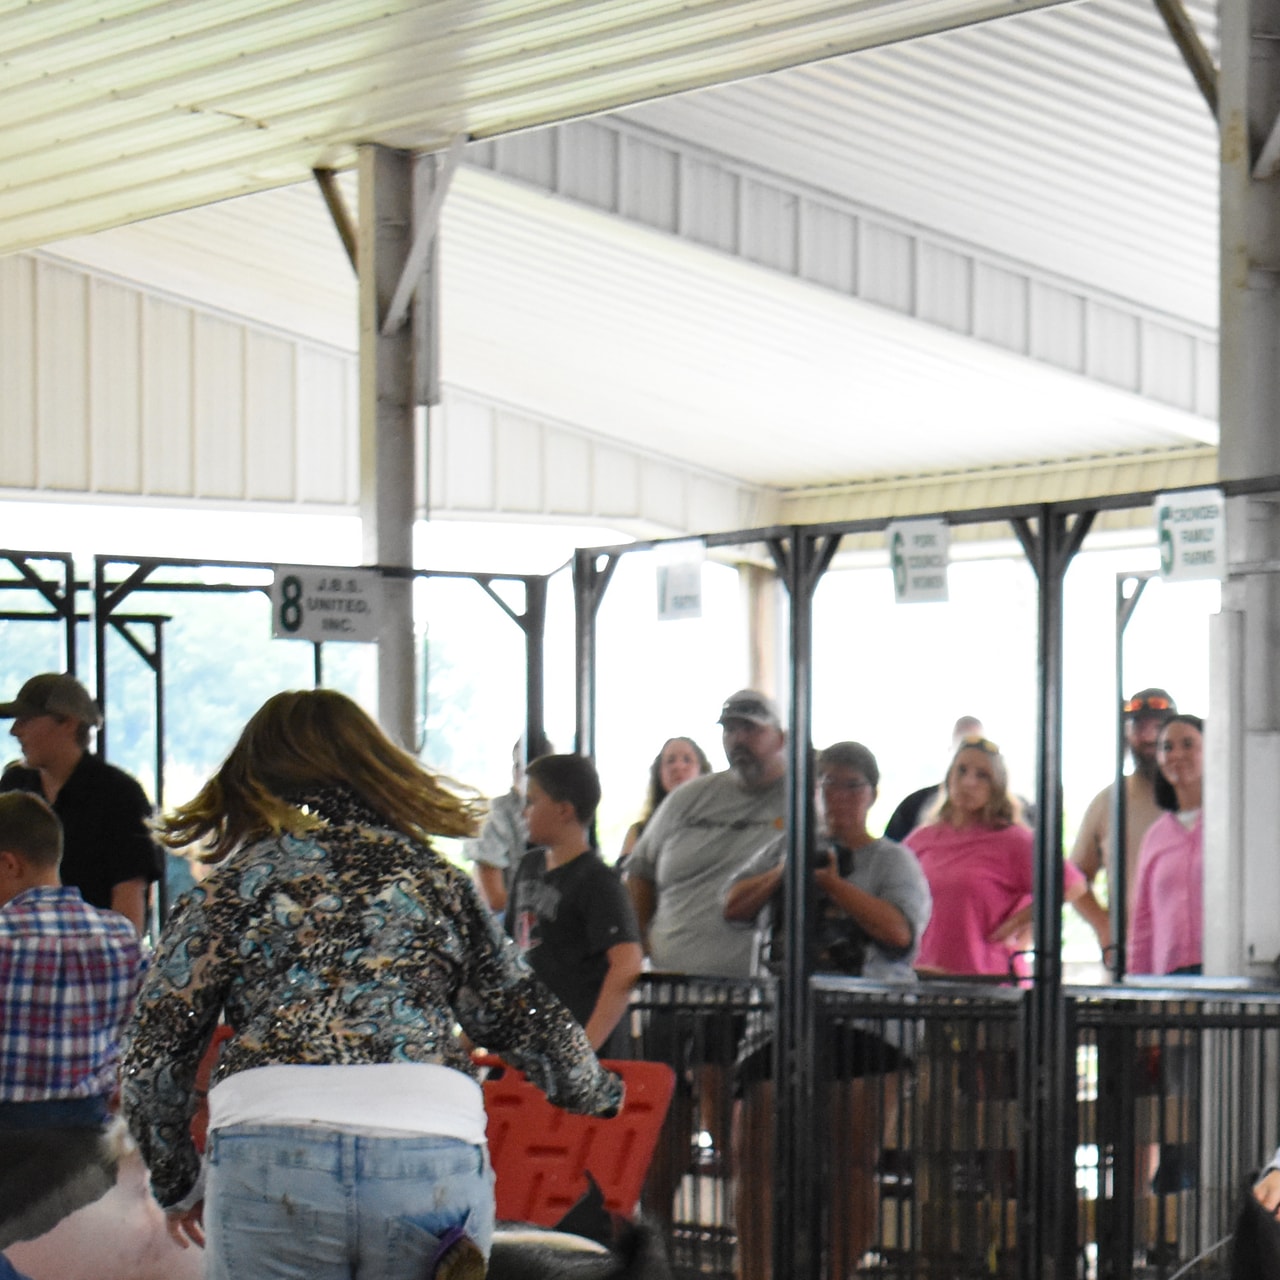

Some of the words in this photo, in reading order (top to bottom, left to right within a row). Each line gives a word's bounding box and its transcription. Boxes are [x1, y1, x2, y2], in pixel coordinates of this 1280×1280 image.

[891, 531, 907, 597] 6
[1160, 506, 1174, 576] 5
[281, 575, 302, 633] 8
